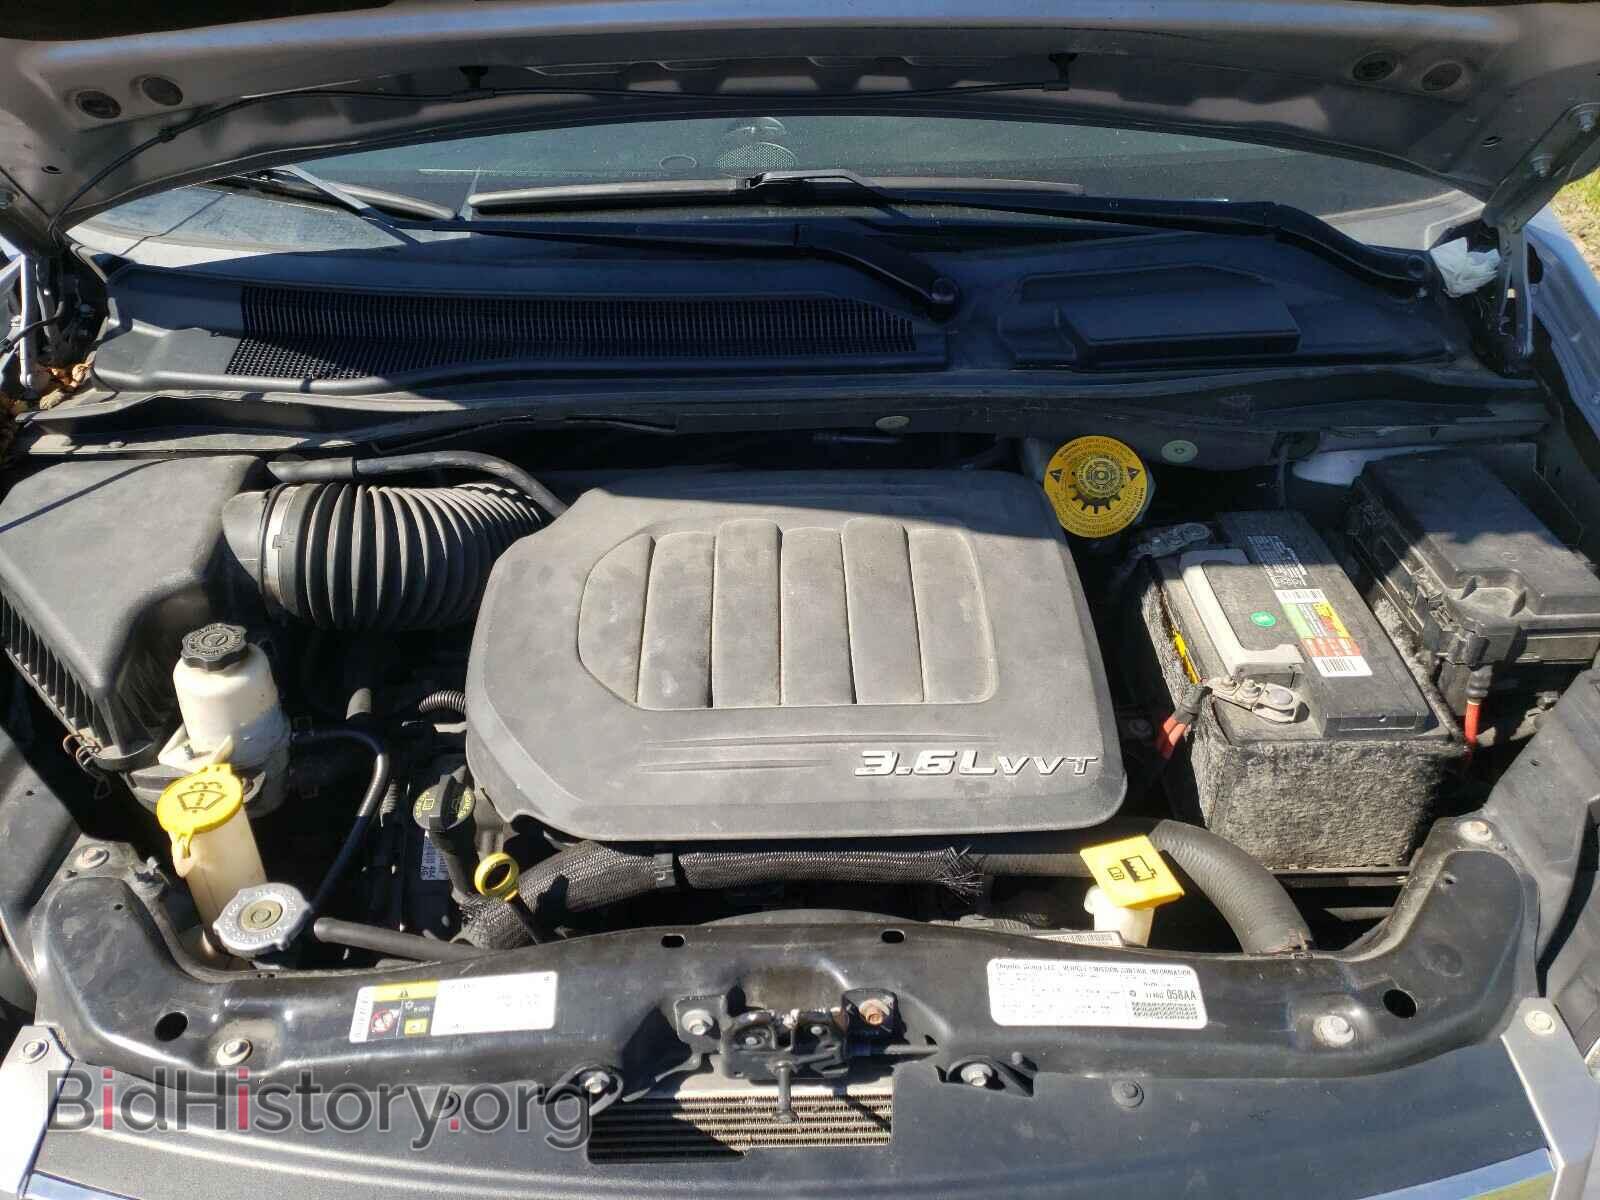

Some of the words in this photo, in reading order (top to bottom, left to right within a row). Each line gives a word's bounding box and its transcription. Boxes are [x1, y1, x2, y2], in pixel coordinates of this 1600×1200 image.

[854, 750, 997, 776] 3.6L
[998, 756, 1098, 776] VVT
[1166, 988, 1197, 1001] 058AA
